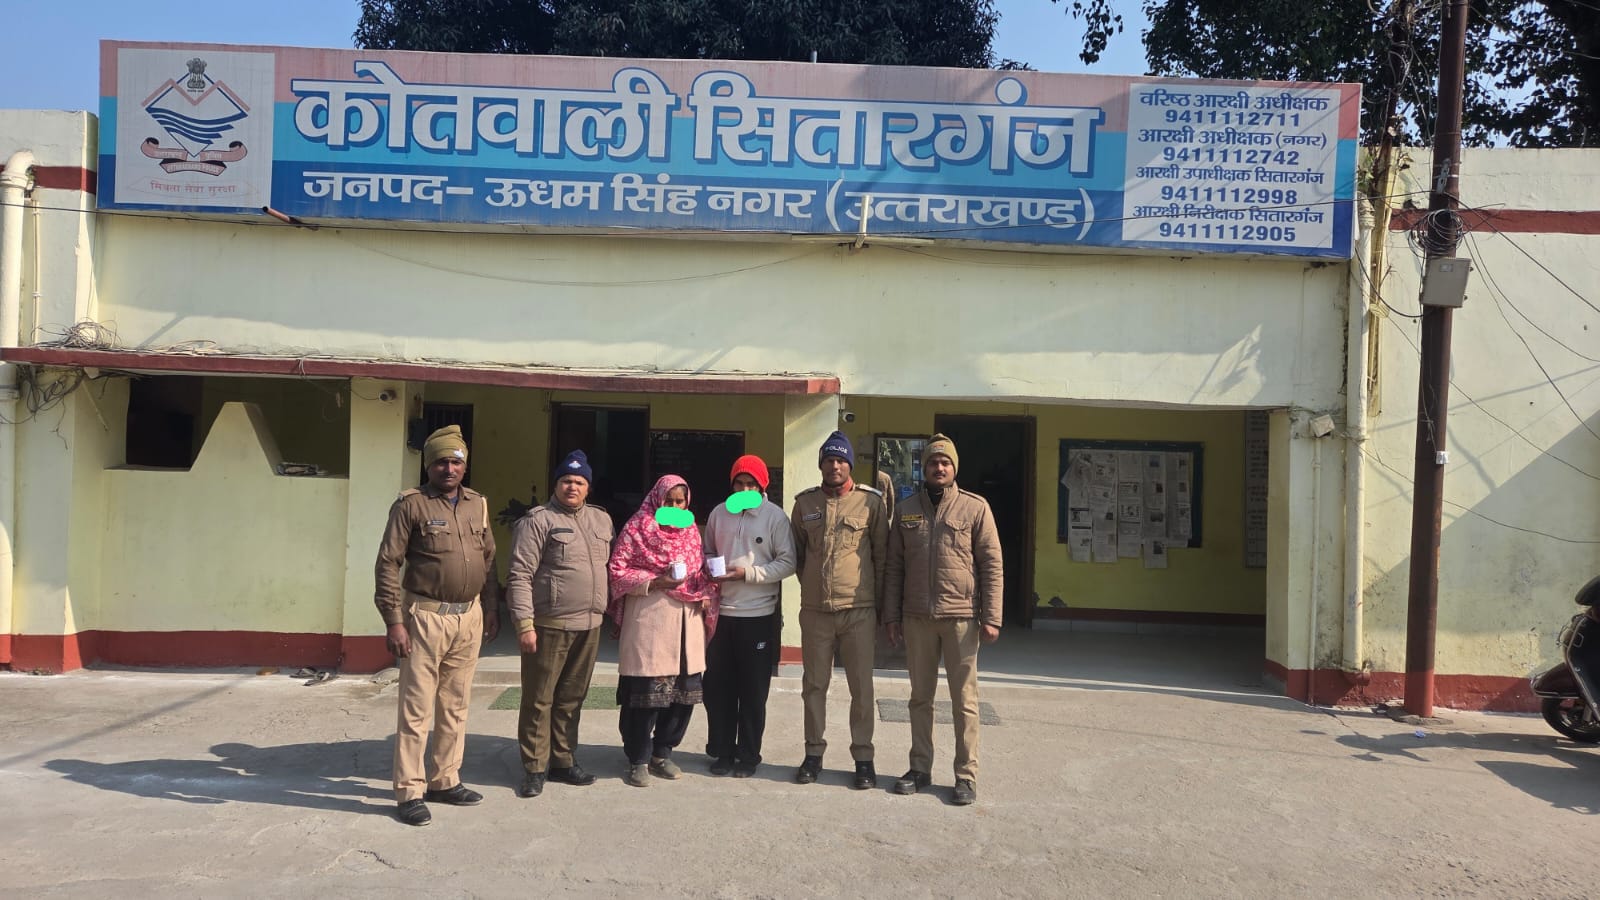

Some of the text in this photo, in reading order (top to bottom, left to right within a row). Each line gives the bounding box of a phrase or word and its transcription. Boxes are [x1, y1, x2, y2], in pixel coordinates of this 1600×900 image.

[1140, 88, 1330, 111] वरिष्ठ आरक्षी अधीक्षक
[291, 61, 1104, 176] कोतवाली सितारगंज
[1165, 109, 1300, 127] 9411112711
[1138, 125, 1327, 150] आरक्षी अधीक्षक (नगर)
[1163, 147, 1300, 165] 9411112742
[1136, 163, 1324, 184] आरक्षी उपाधीक्षक सितारगंज
[1161, 185, 1297, 204] 9411112998
[484, 178, 604, 210] ऊधम
[610, 173, 701, 215] सिंह
[706, 185, 817, 219] नगर
[825, 178, 1095, 241] (उत्तराखण्ड)
[1133, 203, 1324, 223] आरक्षी निरीक्षक सितारगंज
[1160, 222, 1296, 241] 9411112905
